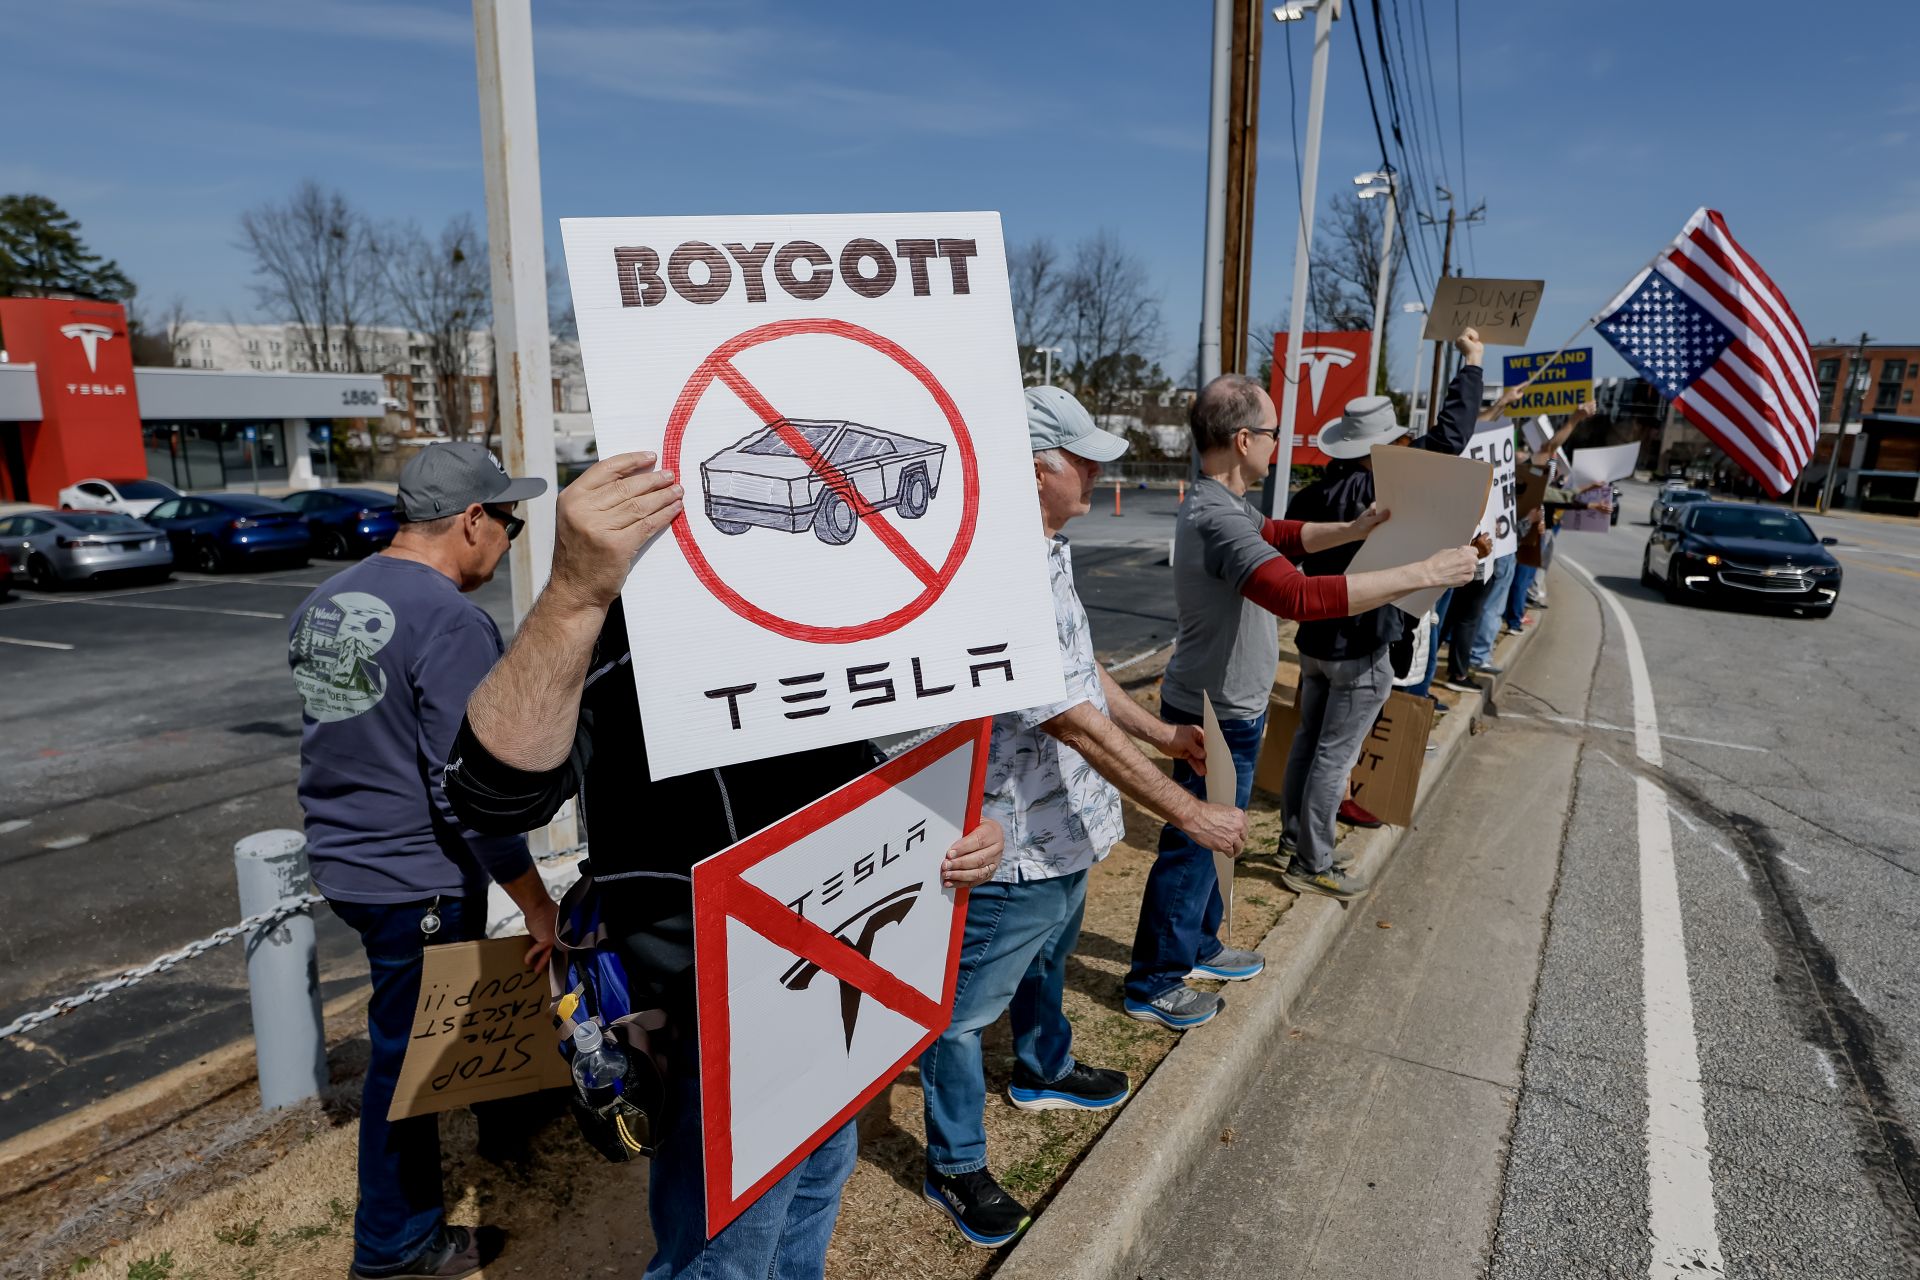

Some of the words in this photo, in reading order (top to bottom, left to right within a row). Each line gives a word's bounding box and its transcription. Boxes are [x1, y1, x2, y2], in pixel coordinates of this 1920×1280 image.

[614, 237, 978, 308] BOYCOTT
[1454, 285, 1537, 309] DUMP
[1452, 310, 1527, 328] MUSK
[1509, 356, 1532, 369] WE
[1535, 351, 1587, 367] STAND
[1527, 367, 1567, 381] WITH
[66, 383, 126, 396] TESLA
[703, 641, 1014, 730] TESLA
[787, 818, 927, 921] TESLA
[413, 994, 545, 1040] FASCIST
[431, 1033, 535, 1091] STOP
